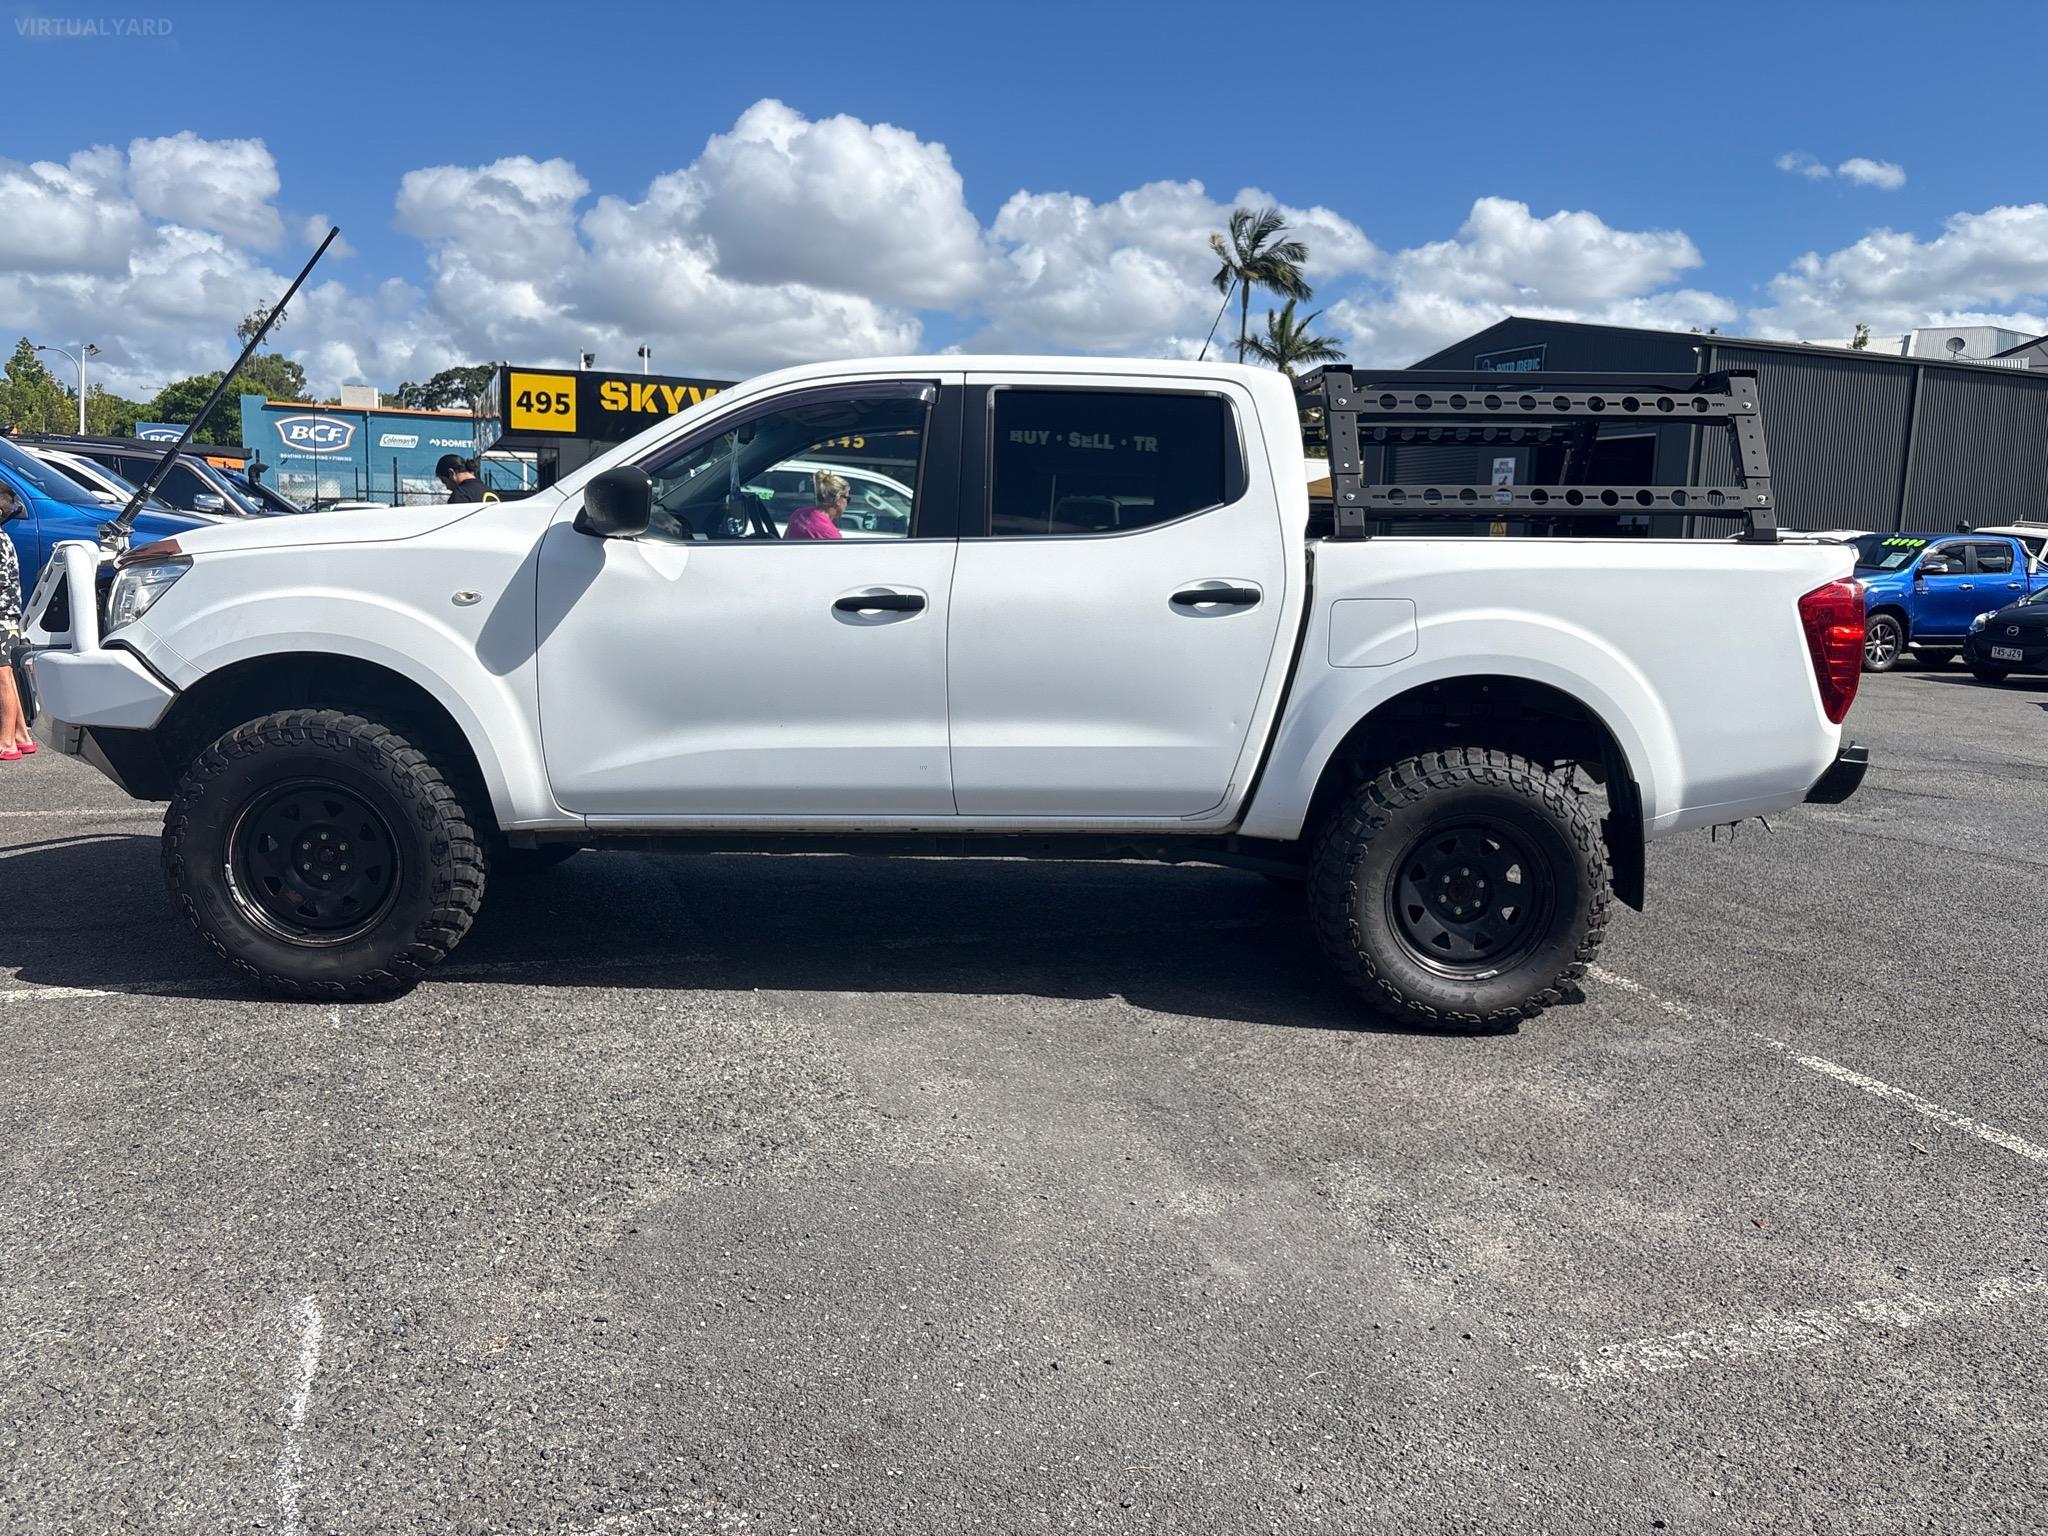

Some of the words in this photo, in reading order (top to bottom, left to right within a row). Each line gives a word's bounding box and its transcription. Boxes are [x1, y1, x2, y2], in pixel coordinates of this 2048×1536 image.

[516, 390, 571, 415] 495
[289, 424, 343, 442] BCF
[1008, 429, 1051, 446] BUY
[1067, 431, 1115, 450] SELL
